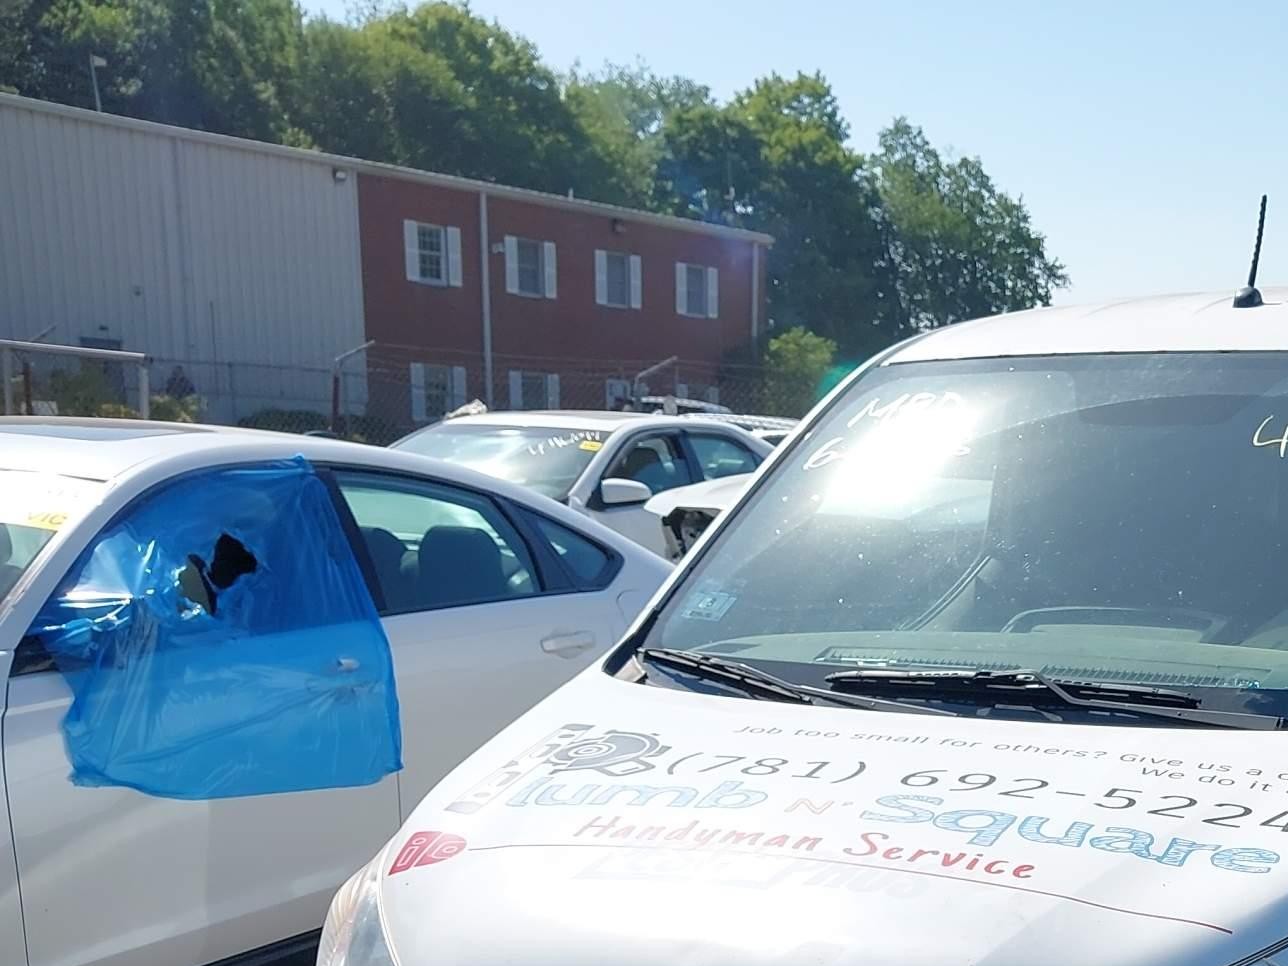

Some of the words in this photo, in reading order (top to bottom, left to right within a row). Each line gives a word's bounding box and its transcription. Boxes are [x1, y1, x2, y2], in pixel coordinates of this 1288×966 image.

[667, 753, 868, 785] (781)
[733, 725, 783, 735] Job
[794, 728, 840, 739] too
[850, 732, 929, 744] small
[939, 737, 983, 749] for
[993, 742, 1107, 760] others?
[1119, 753, 1185, 767] Give
[1197, 762, 1232, 774] us
[1245, 768, 1263, 776] a
[1141, 767, 1185, 780] We
[1198, 774, 1236, 788] do
[1249, 780, 1272, 793] it
[573, 815, 823, 852] Handyman
[843, 831, 1036, 880] Service
